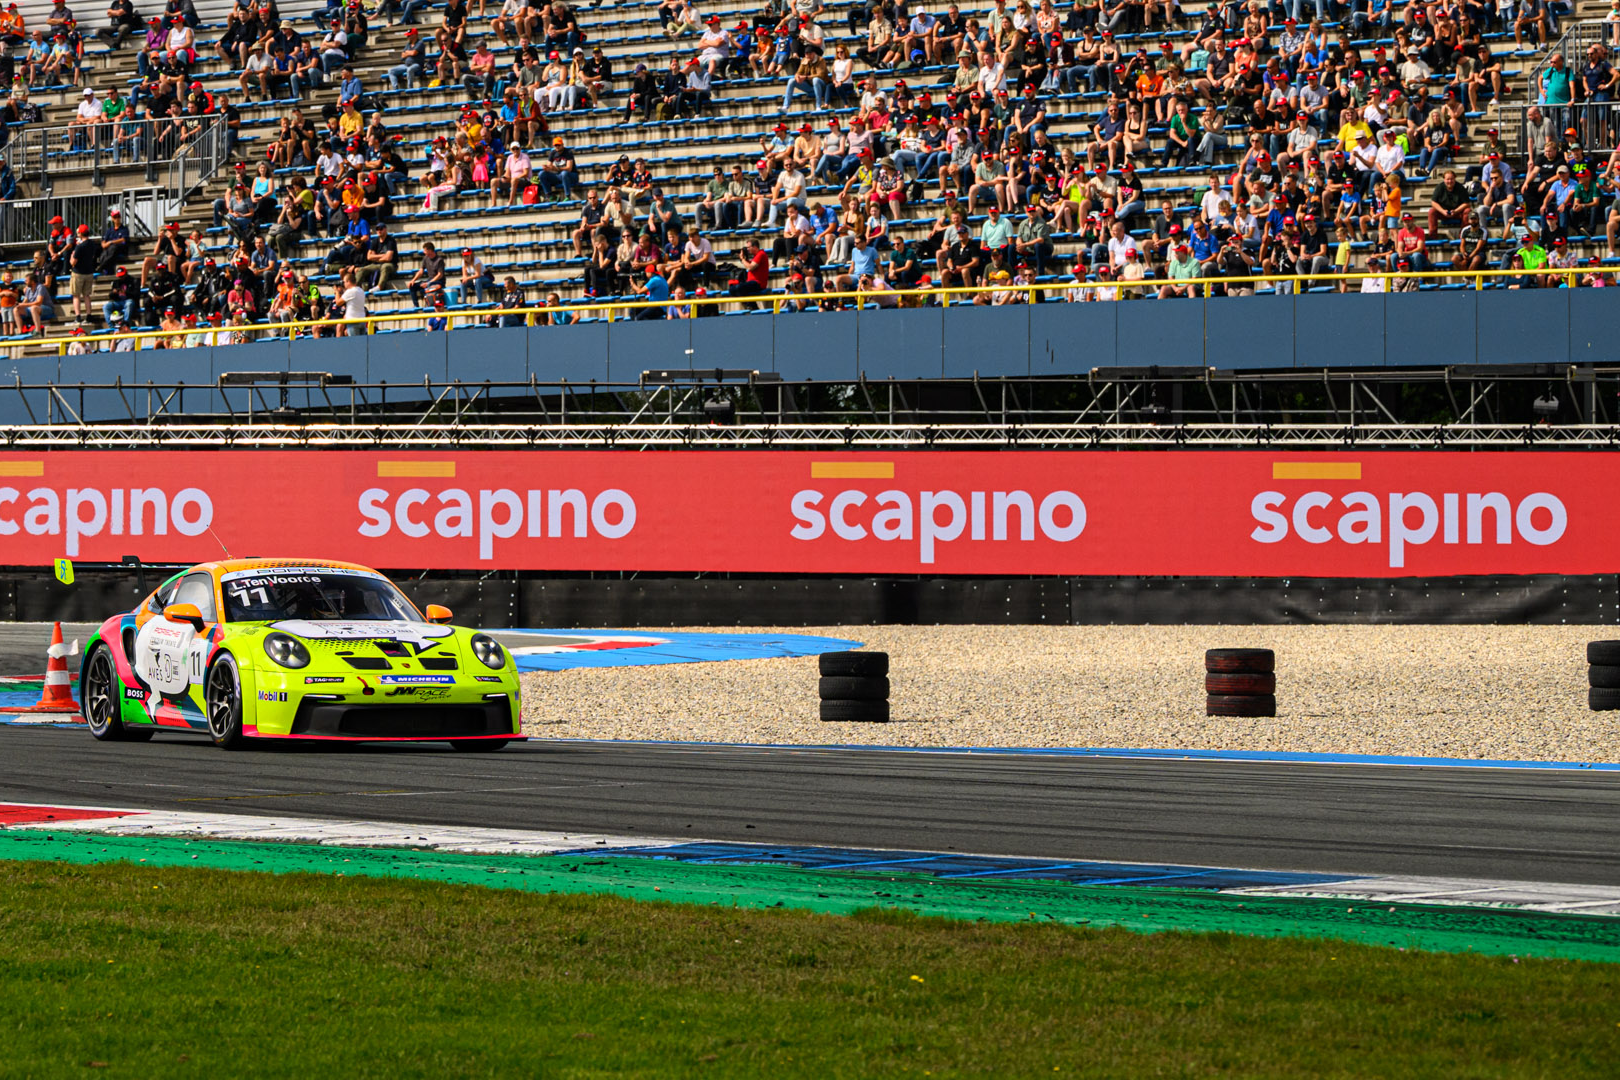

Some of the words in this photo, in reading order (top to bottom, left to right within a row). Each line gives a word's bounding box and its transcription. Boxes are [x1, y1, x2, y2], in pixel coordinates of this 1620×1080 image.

[358, 488, 636, 559] scapino
[791, 490, 1086, 563] scapino
[1251, 492, 1567, 567] scapino
[232, 587, 270, 607] 11
[190, 650, 202, 677] 11
[126, 689, 144, 699] BOSS
[257, 690, 278, 702] Mobil
